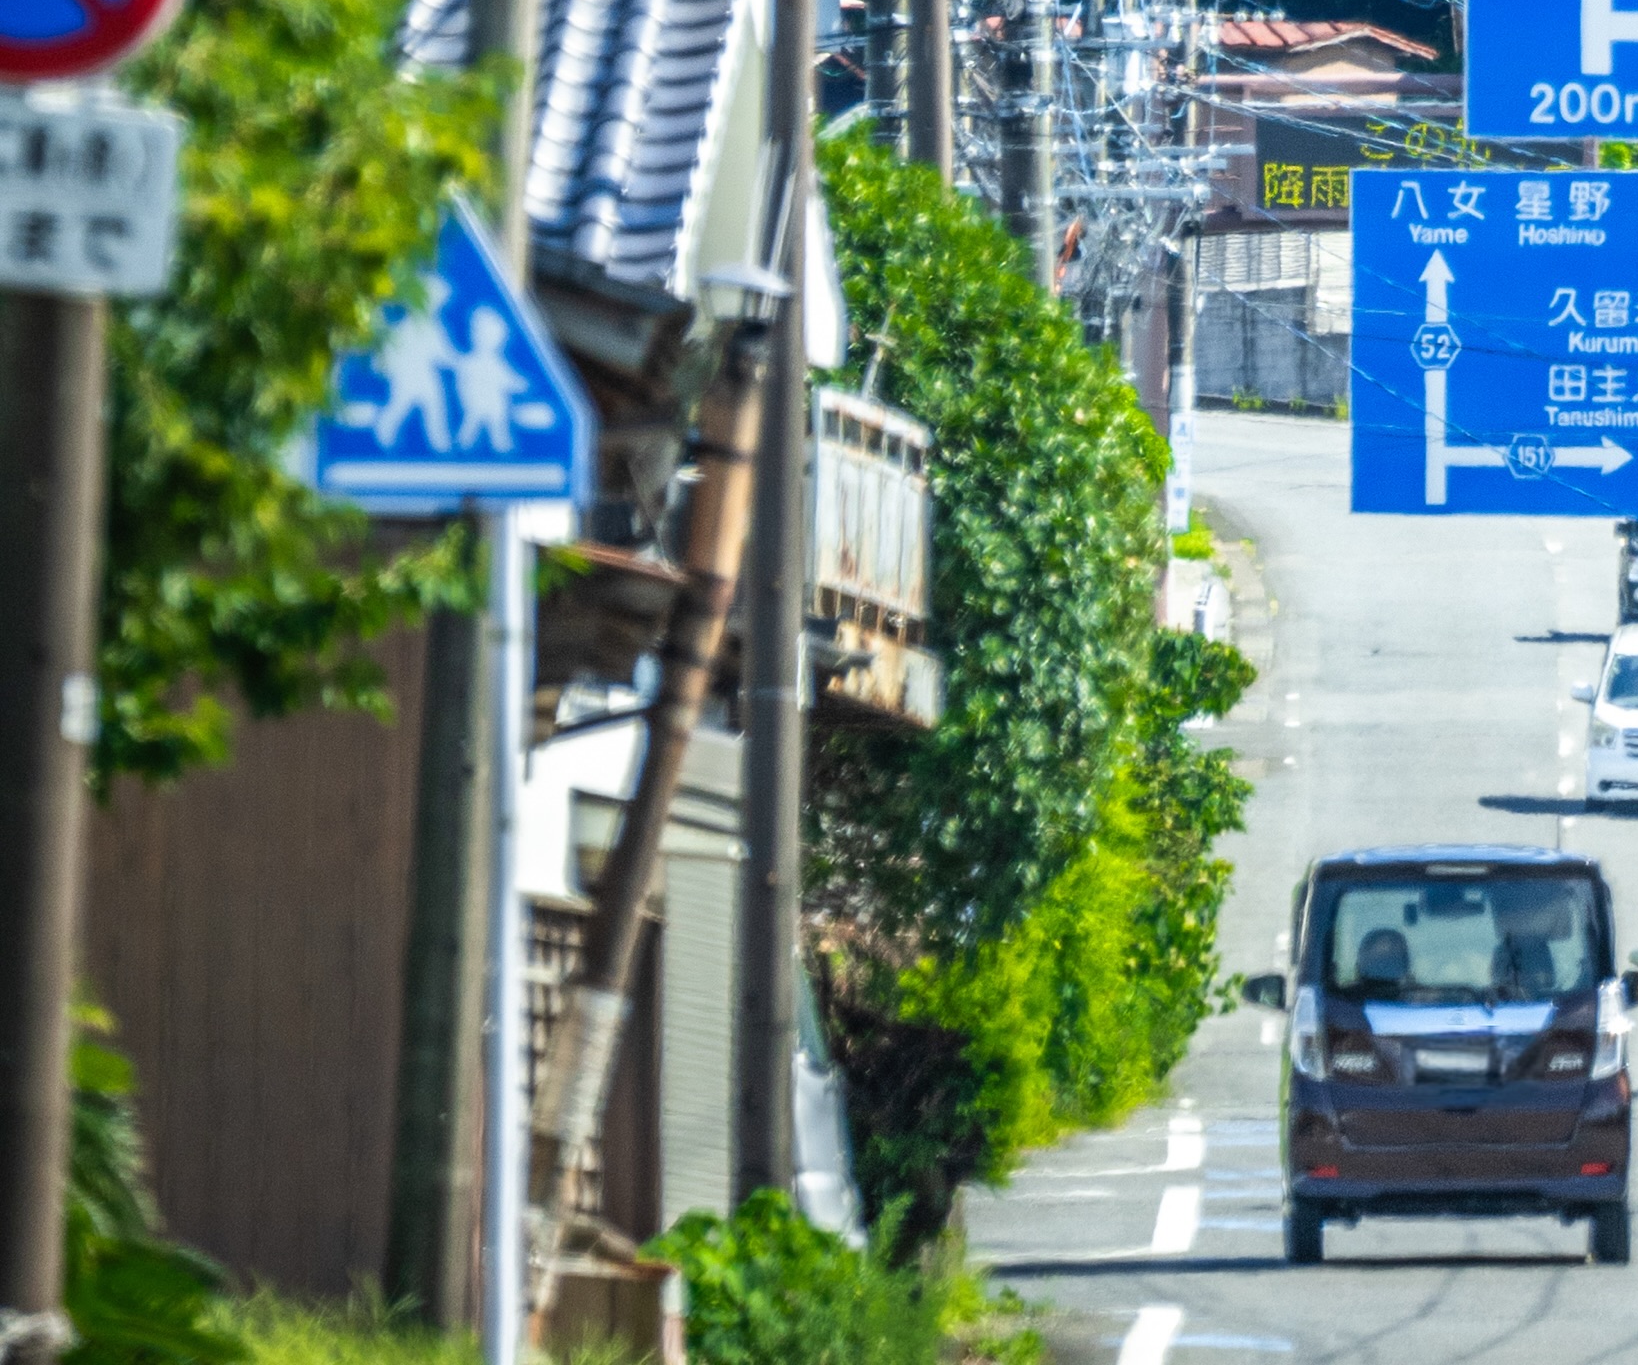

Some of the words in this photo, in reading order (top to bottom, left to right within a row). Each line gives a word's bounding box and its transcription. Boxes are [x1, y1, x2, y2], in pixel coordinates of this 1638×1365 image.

[1391, 180, 1485, 220] 八女
[1515, 181, 1611, 221] 星野
[1409, 224, 1468, 244] Yame
[1519, 224, 1606, 246] Hoshino
[1420, 334, 1451, 360] 52
[1518, 445, 1545, 466] 151
